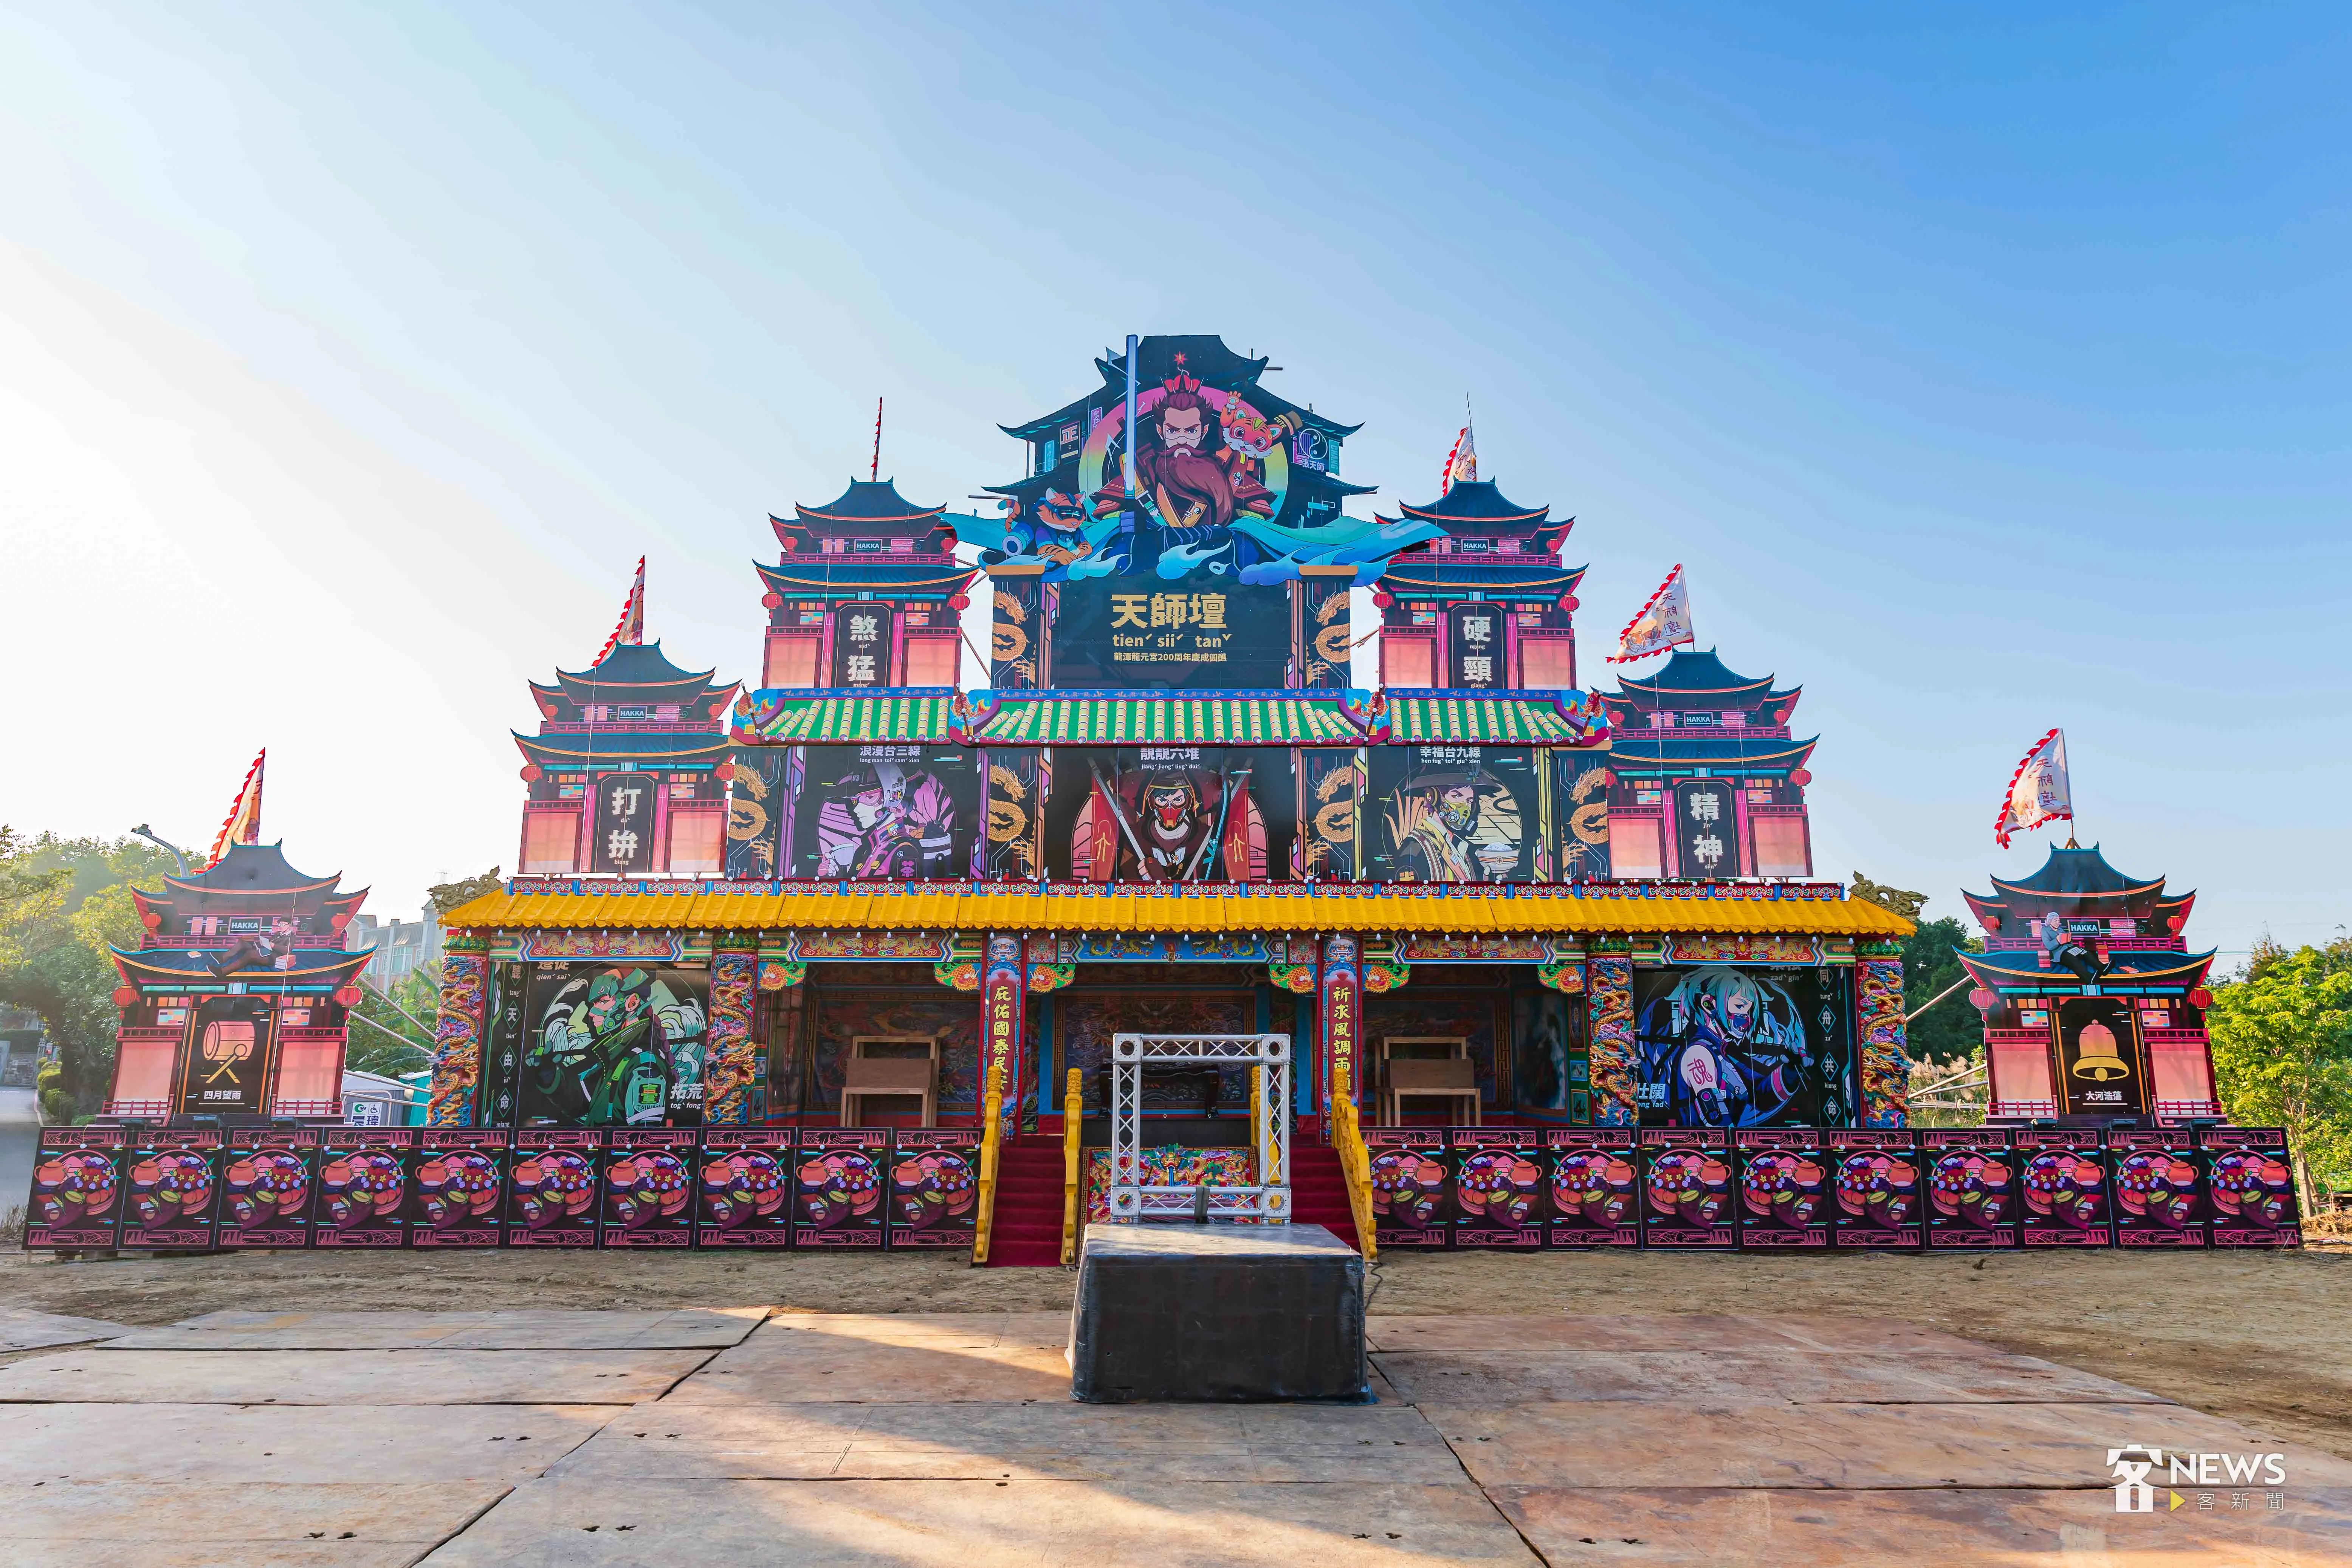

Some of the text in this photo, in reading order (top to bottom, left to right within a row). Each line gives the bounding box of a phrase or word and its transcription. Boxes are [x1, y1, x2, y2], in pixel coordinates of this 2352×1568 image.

[1274, 416, 1286, 429] CUTE
[1061, 425, 1078, 445] 正
[1302, 458, 1325, 472] 張天師
[1111, 592, 1227, 629] 天師壇
[860, 745, 920, 756] 浪漫台三線
[1140, 747, 1199, 760] 靚靚六堆
[1420, 746, 1481, 758] 幸福台九線
[612, 787, 641, 815] 打
[892, 791, 902, 800] HK
[1690, 793, 1720, 820] 精
[1693, 834, 1724, 863] 神
[511, 964, 521, 979] 聽
[1820, 969, 1829, 983] 同
[508, 1008, 517, 1021] 天
[1822, 1010, 1831, 1025] 舟
[1333, 987, 1351, 1091] 祈求風調雨
[504, 1051, 513, 1066] 由
[1825, 1058, 1834, 1073] 共
[203, 1090, 242, 1100] 四月望雨
[670, 1083, 705, 1099] 拓荒
[2086, 1091, 2122, 1101] 大河浩蕩
[500, 1094, 510, 1110] 命
[1827, 1101, 1836, 1116] 命
